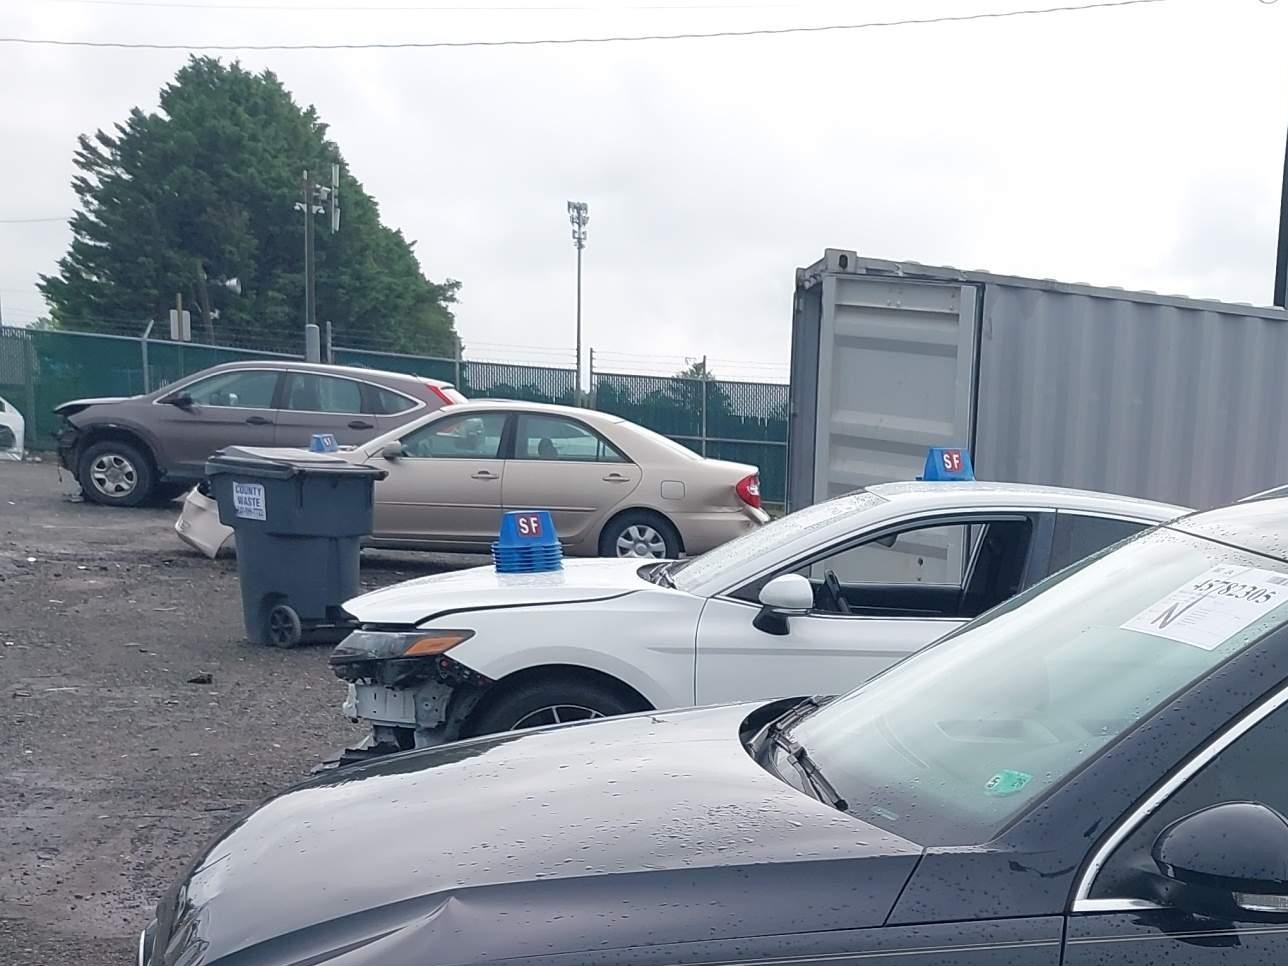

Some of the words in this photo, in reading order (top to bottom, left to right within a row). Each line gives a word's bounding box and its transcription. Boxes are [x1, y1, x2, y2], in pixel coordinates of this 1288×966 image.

[943, 454, 960, 469] SF
[238, 496, 261, 508] WASTE
[519, 517, 538, 534] SF
[1193, 578, 1277, 604] 45782305
